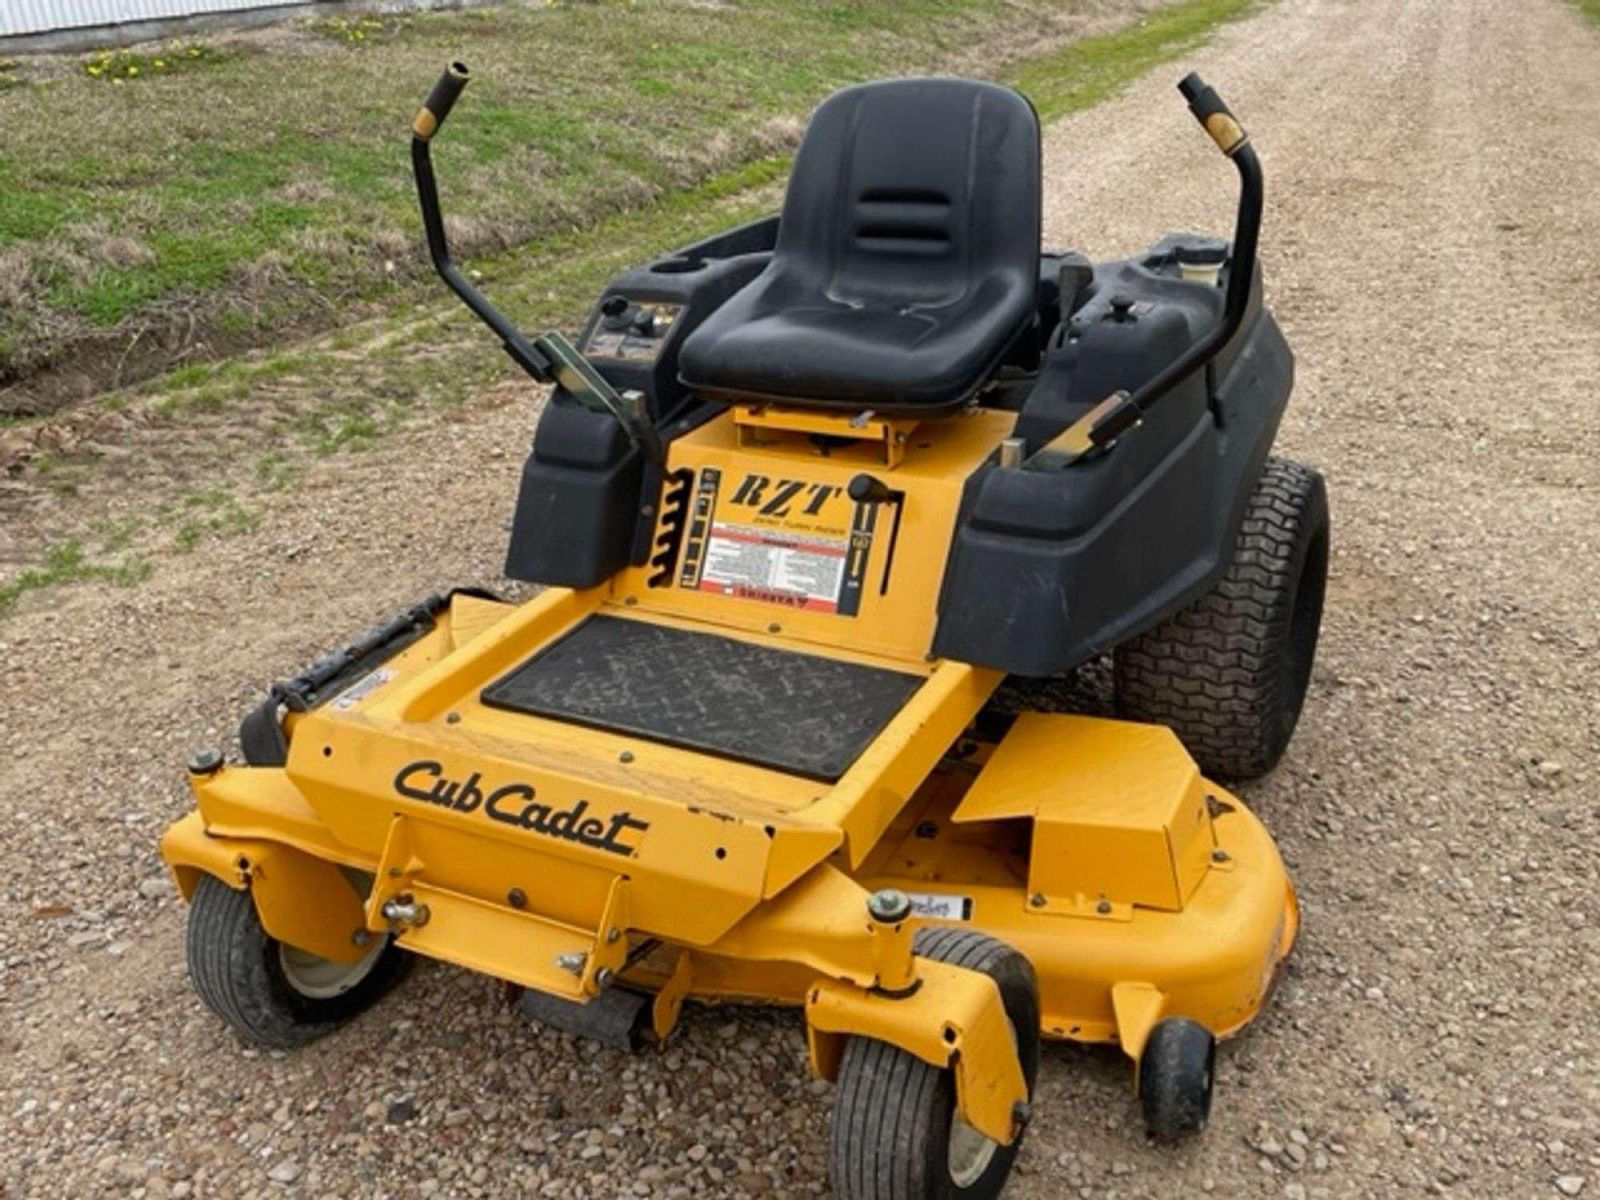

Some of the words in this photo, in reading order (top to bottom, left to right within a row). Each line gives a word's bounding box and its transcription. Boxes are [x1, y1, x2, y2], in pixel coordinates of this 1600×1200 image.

[730, 475, 842, 517] RZT
[394, 760, 483, 813] Cub
[485, 784, 650, 857] Cadet
